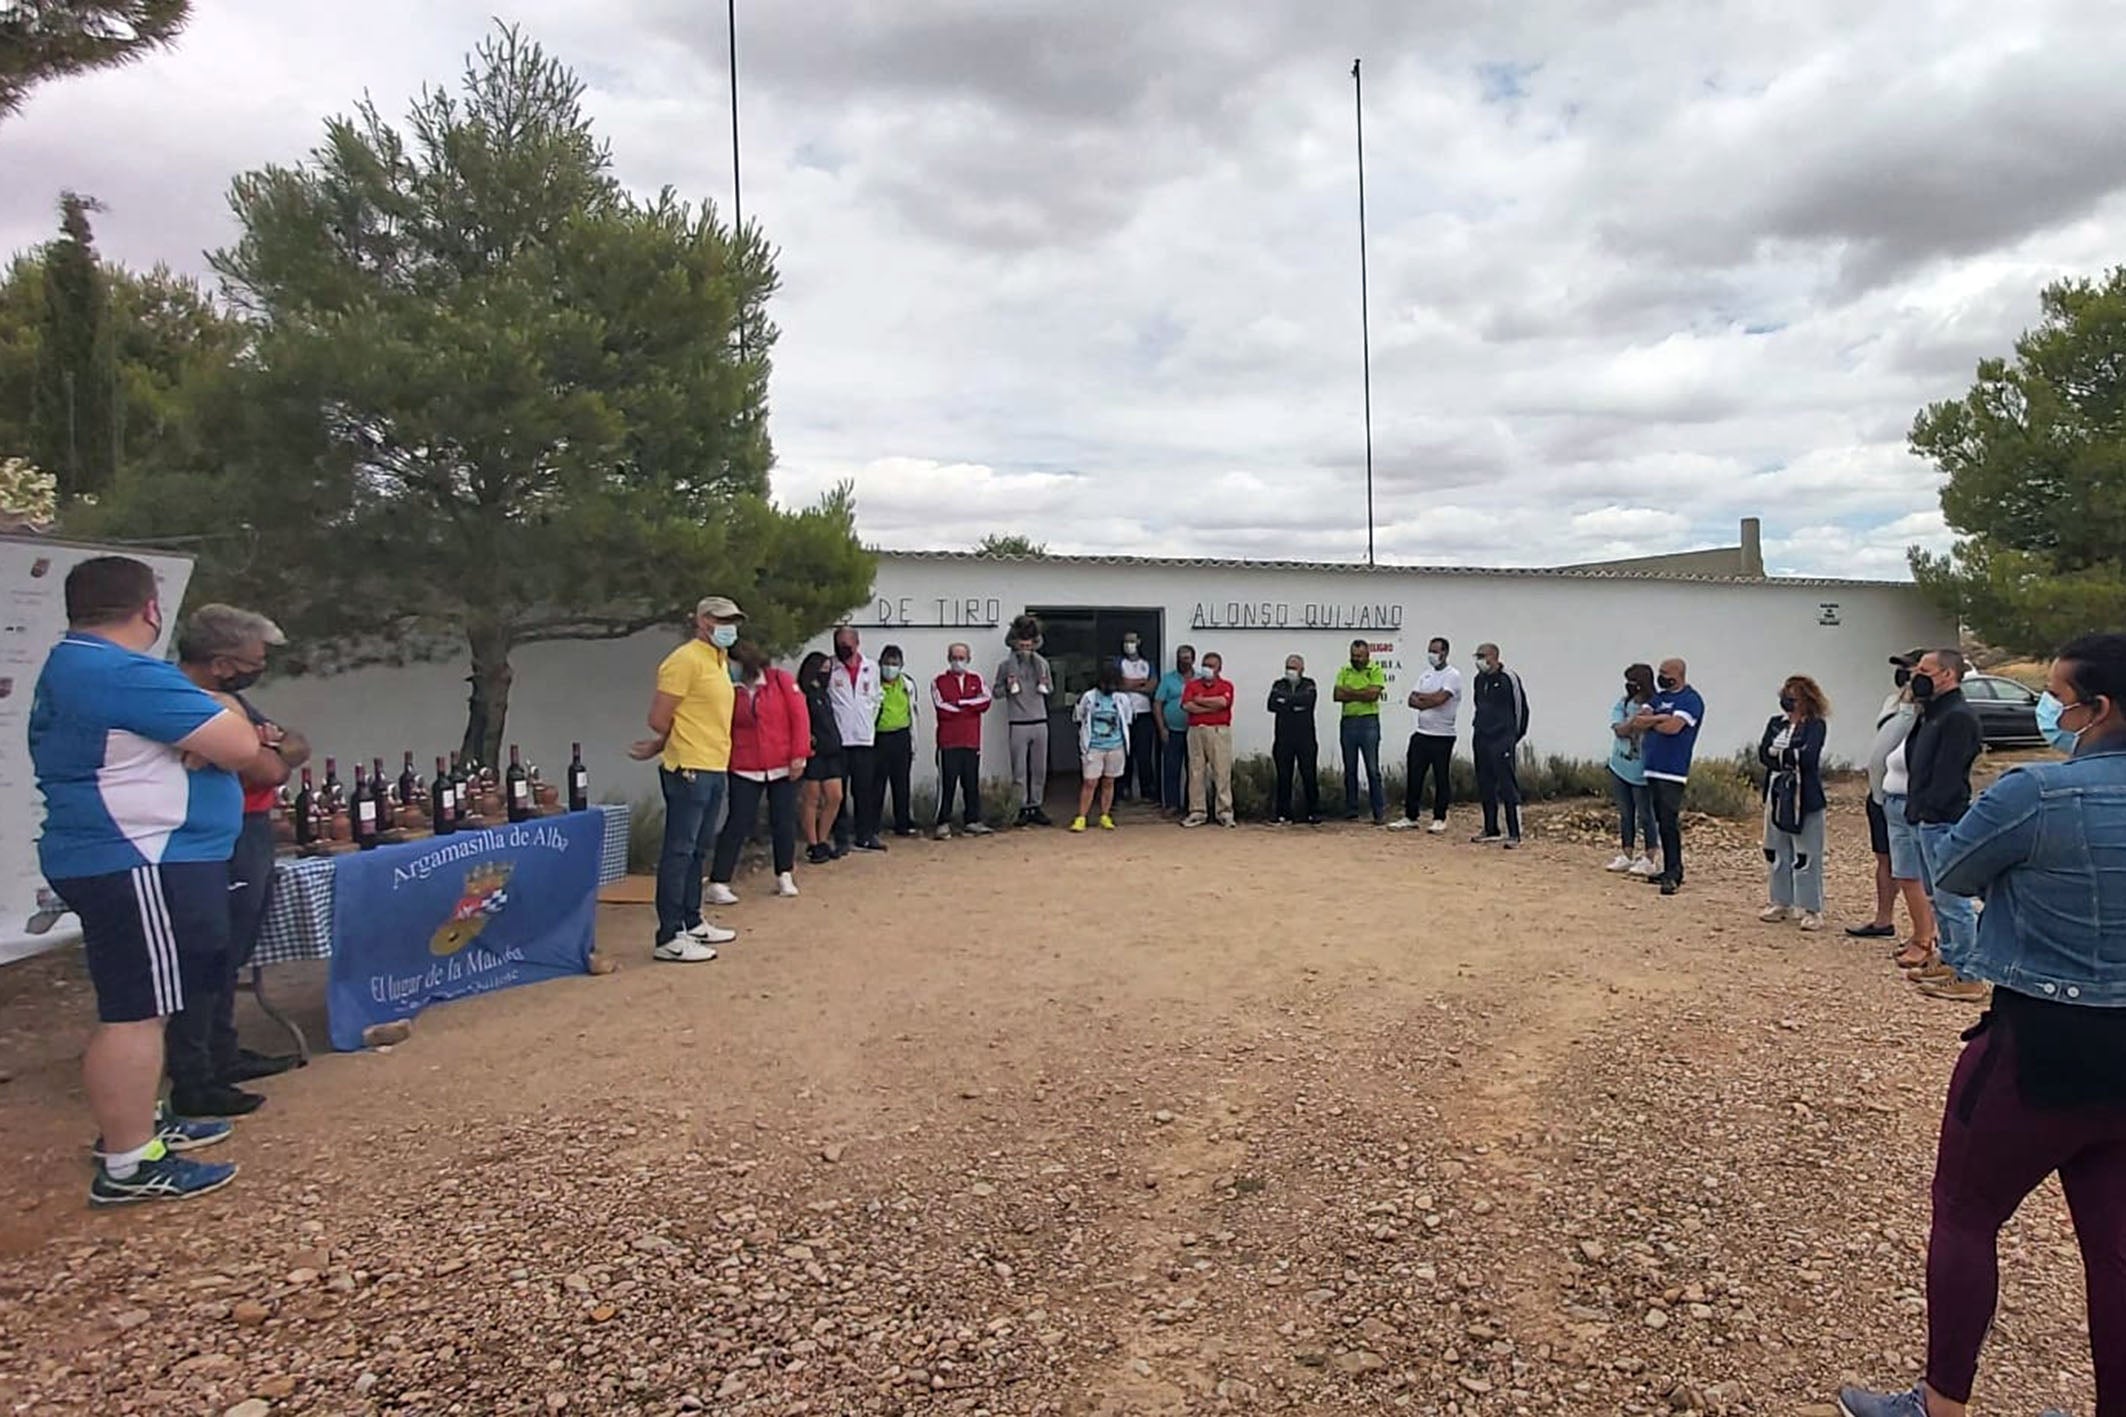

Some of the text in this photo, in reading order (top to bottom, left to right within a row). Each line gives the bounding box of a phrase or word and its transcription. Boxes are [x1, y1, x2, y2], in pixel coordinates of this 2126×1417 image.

[879, 598, 913, 624] DE
[936, 599, 999, 626] TIRO
[1191, 603, 1403, 629] ALONSO QUIJANO
[393, 826, 569, 890] Argamasilla de Alba
[371, 975, 386, 1002] El
[425, 963, 443, 988] de
[448, 957, 462, 982] la
